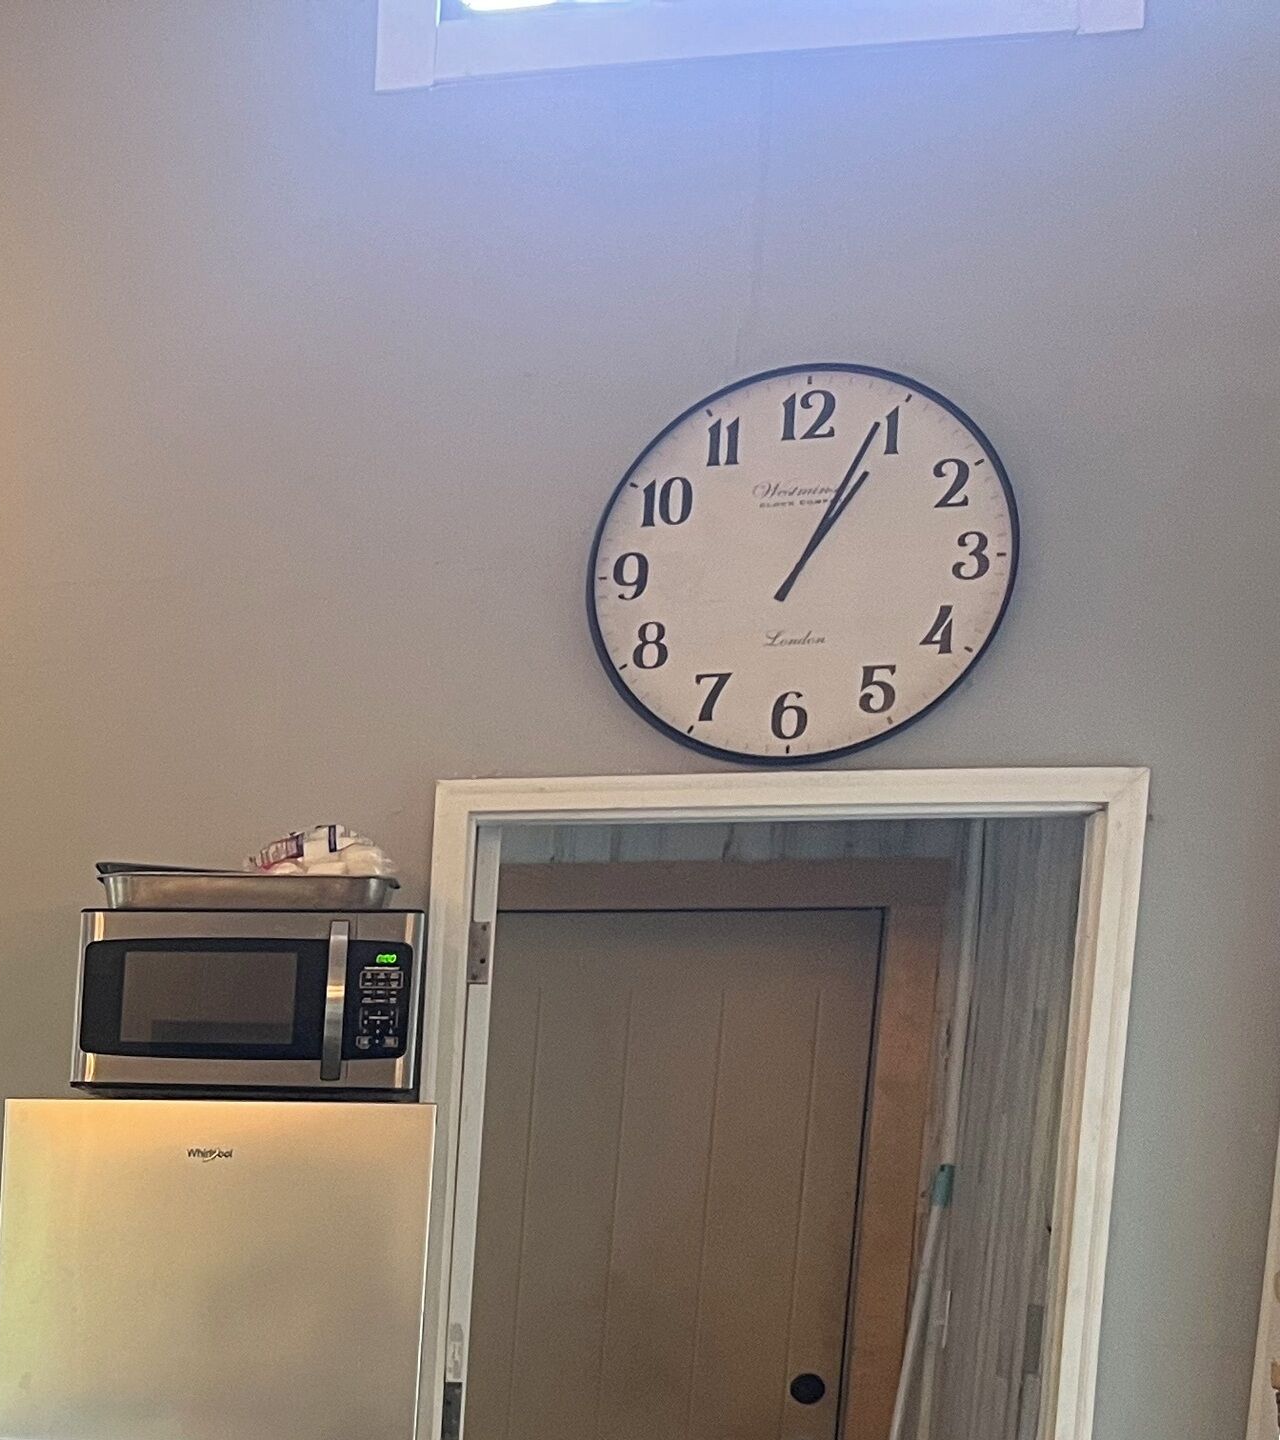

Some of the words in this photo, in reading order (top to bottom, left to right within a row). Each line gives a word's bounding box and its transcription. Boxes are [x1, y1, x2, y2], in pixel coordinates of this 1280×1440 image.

[780, 389, 836, 441] 12
[883, 405, 900, 455] 1
[705, 416, 741, 466] 11
[640, 476, 693, 527] 10
[933, 458, 970, 508] 2
[612, 551, 650, 600] 9
[951, 531, 990, 580] 3
[632, 621, 669, 669] 8
[763, 629, 826, 646] London
[919, 604, 954, 655] 4
[694, 672, 733, 722] 7
[858, 664, 897, 713] 5
[770, 690, 809, 740] 6
